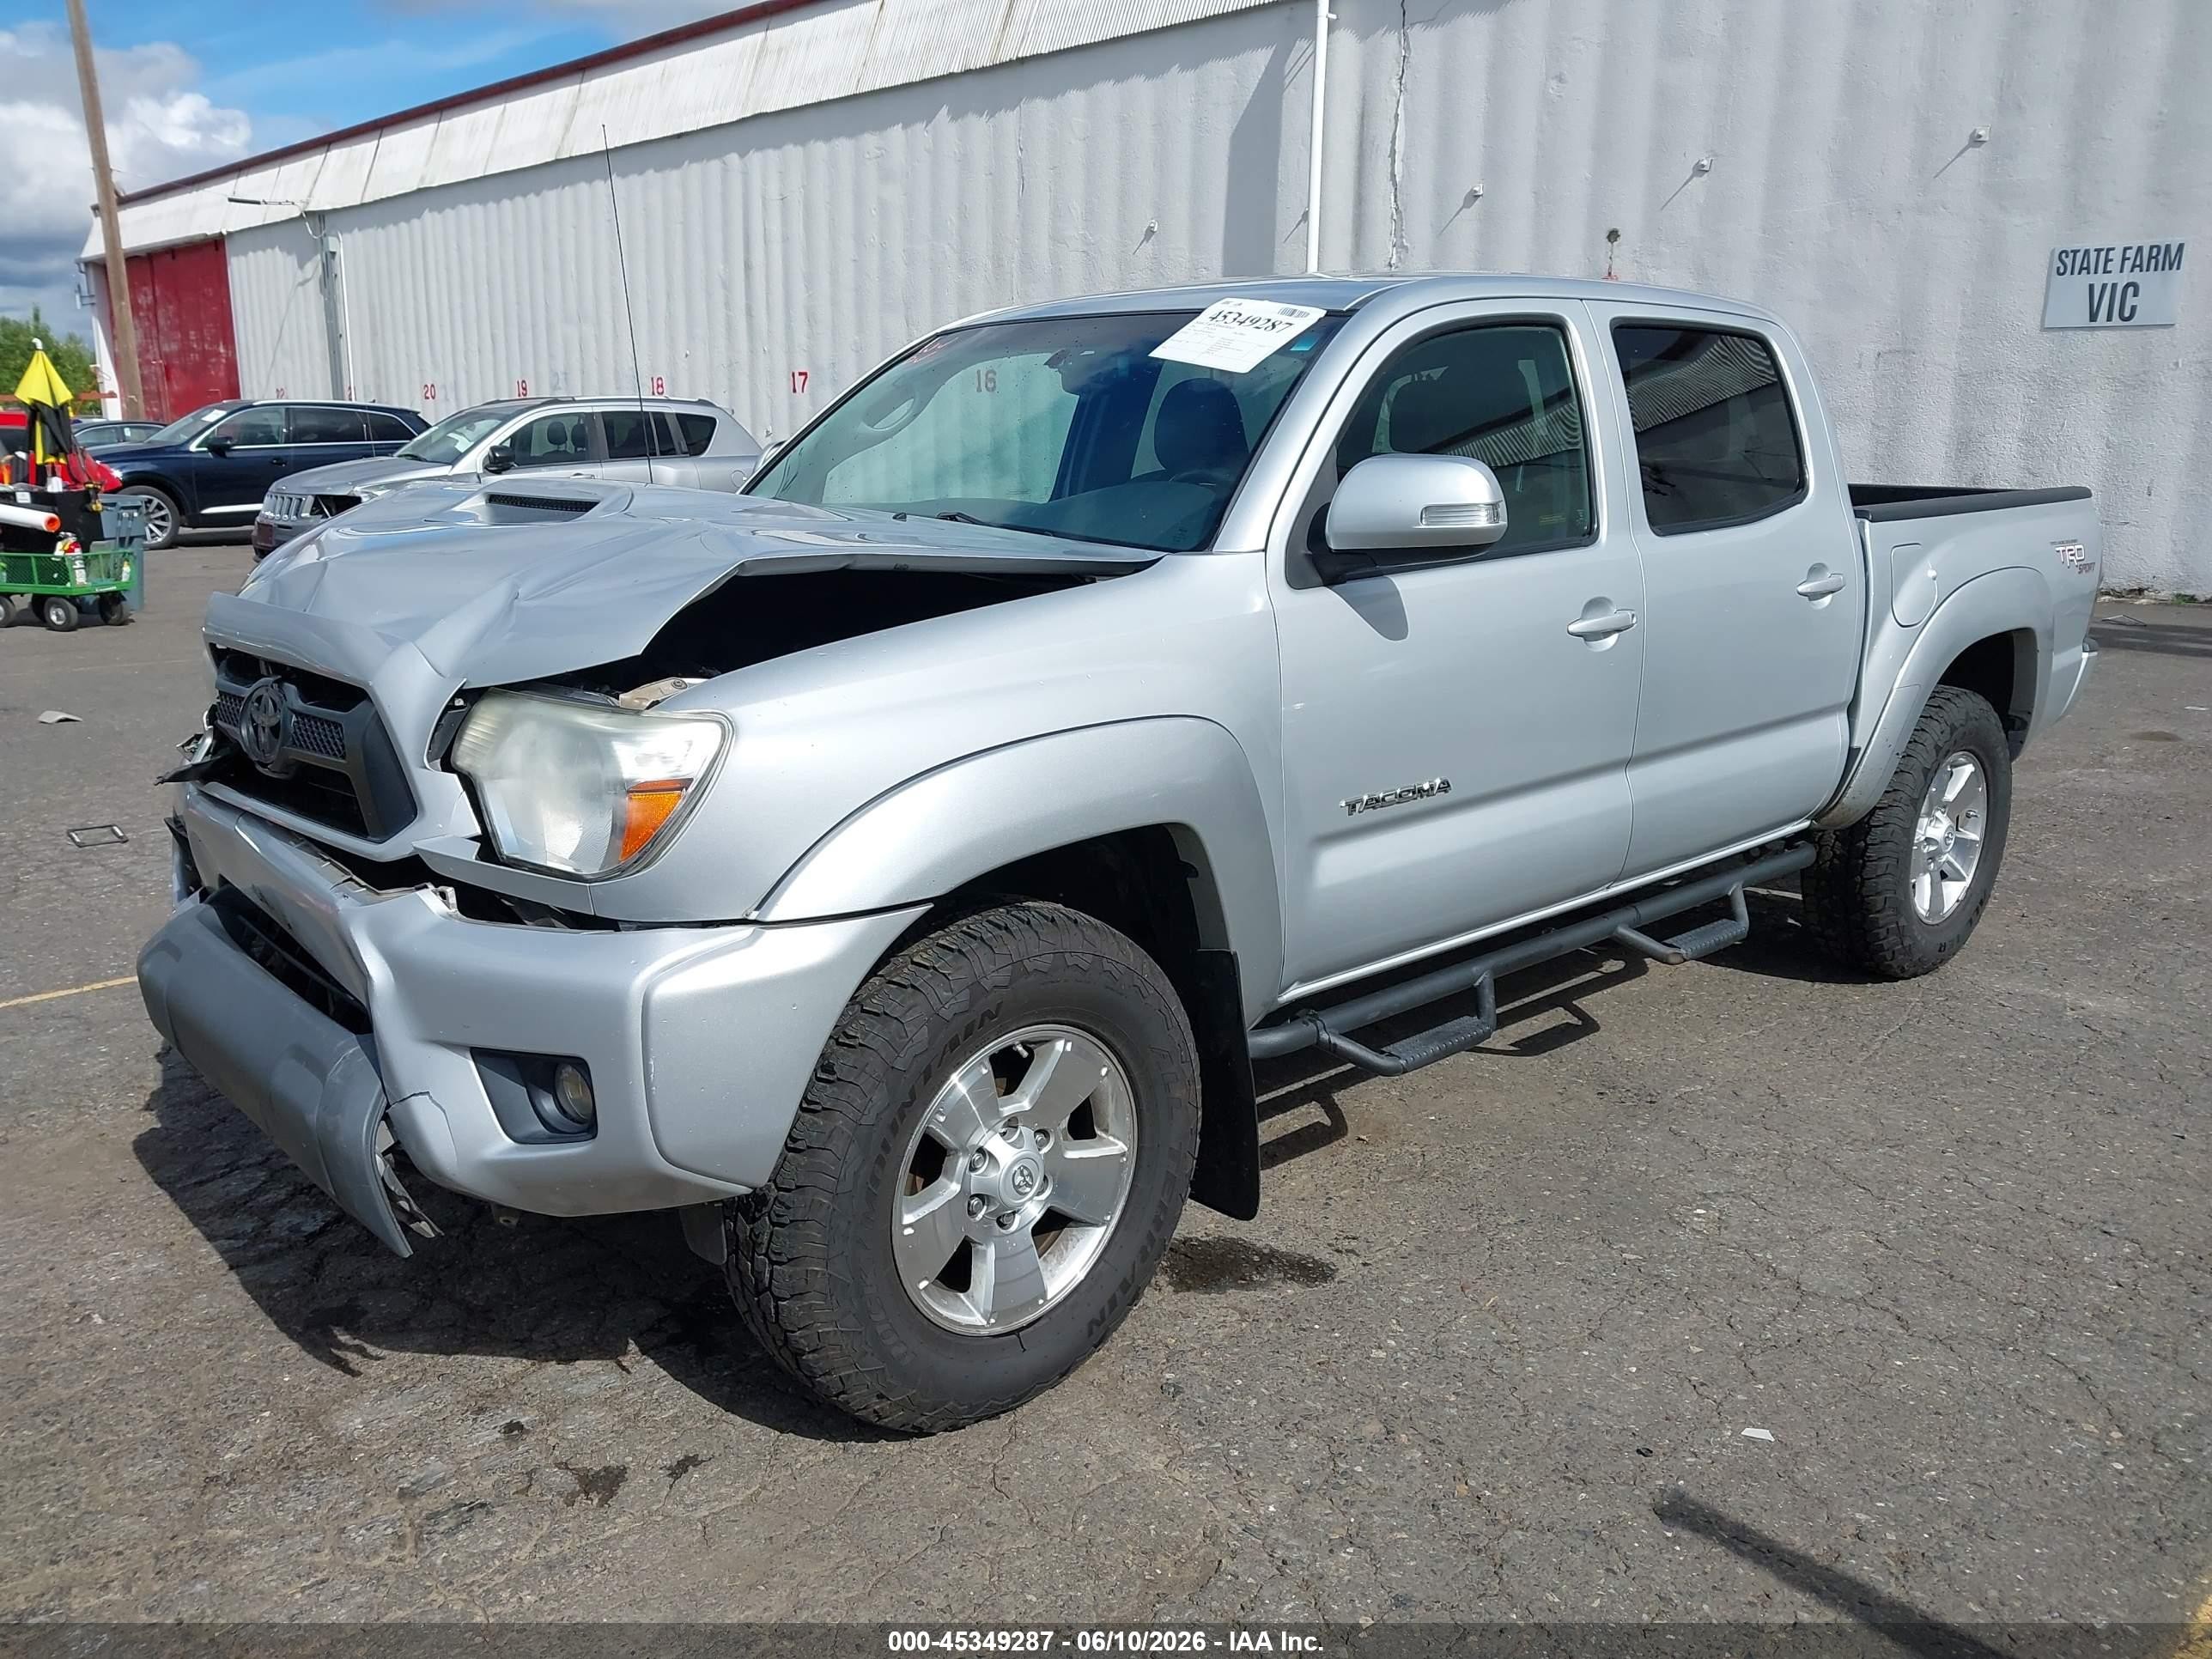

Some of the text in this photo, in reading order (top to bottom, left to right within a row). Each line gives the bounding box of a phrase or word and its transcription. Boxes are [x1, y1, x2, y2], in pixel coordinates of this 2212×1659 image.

[2056, 242, 2185, 276] STATE FARM
[2088, 281, 2140, 323] VIC
[1208, 309, 1296, 334] 45349287
[423, 383, 436, 400] 20
[516, 379, 528, 398] 19
[650, 376, 665, 396] 18
[791, 370, 809, 394] 17
[975, 368, 998, 393] 16
[2055, 544, 2085, 568] TRD
[1340, 776, 1453, 816] TACOMA
